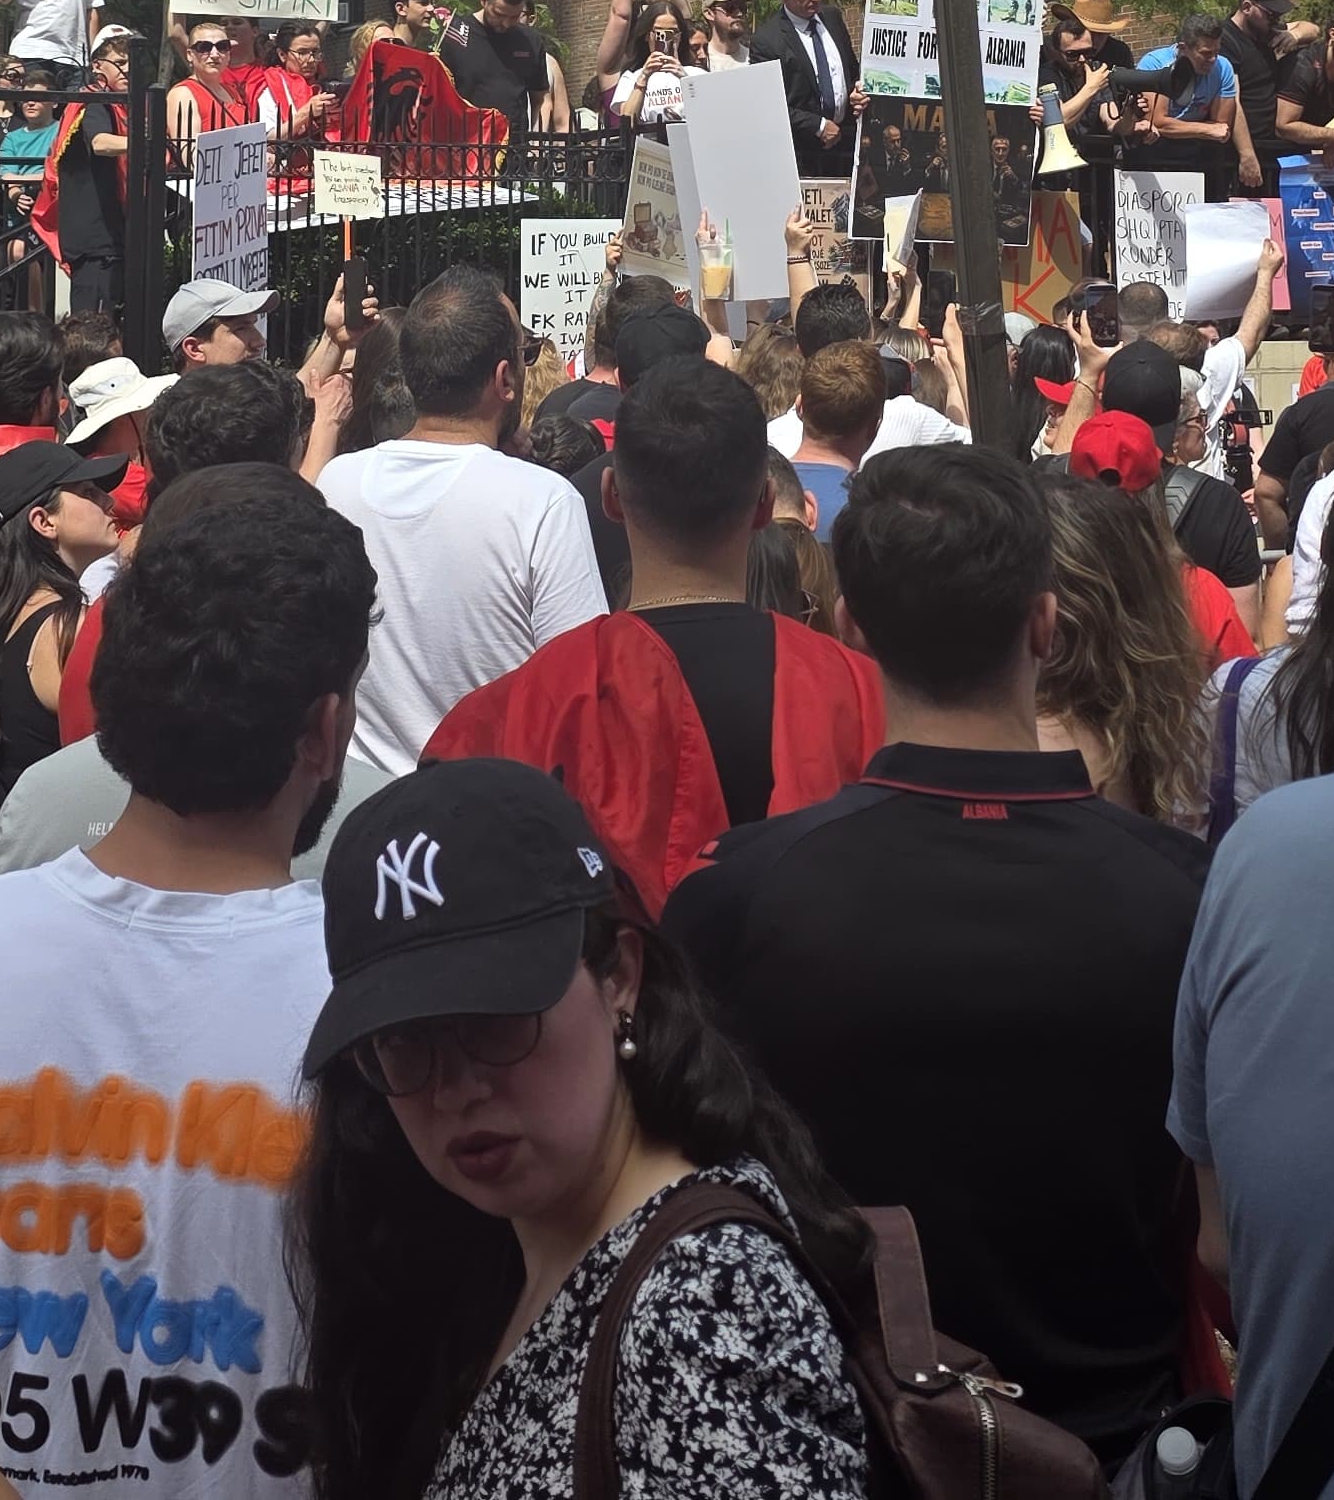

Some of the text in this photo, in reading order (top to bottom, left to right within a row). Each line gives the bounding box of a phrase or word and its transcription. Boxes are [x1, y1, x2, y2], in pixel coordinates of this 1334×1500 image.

[870, 27, 1026, 68] JUSTICE FOR ALBANIA
[648, 94, 683, 106] ALBAN
[903, 104, 998, 136] MAA
[196, 145, 224, 187] DETI
[801, 188, 826, 207] ETI,
[195, 202, 267, 261] FITIM PRIVA
[1117, 217, 1185, 240] SHQIPTA
[531, 233, 547, 255] IF
[550, 233, 577, 252] YOU
[559, 253, 577, 266] IT
[524, 273, 550, 288] WE
[557, 272, 591, 287] WILL
[564, 290, 587, 304] IT
[531, 314, 555, 329] FK
[560, 333, 584, 345] IVA
[962, 803, 1008, 820] ALBANIA
[174, 1080, 309, 1189] Kle
[99, 1268, 264, 1374] York
[72, 1368, 244, 1466] W39
[252, 1384, 317, 1479] S
